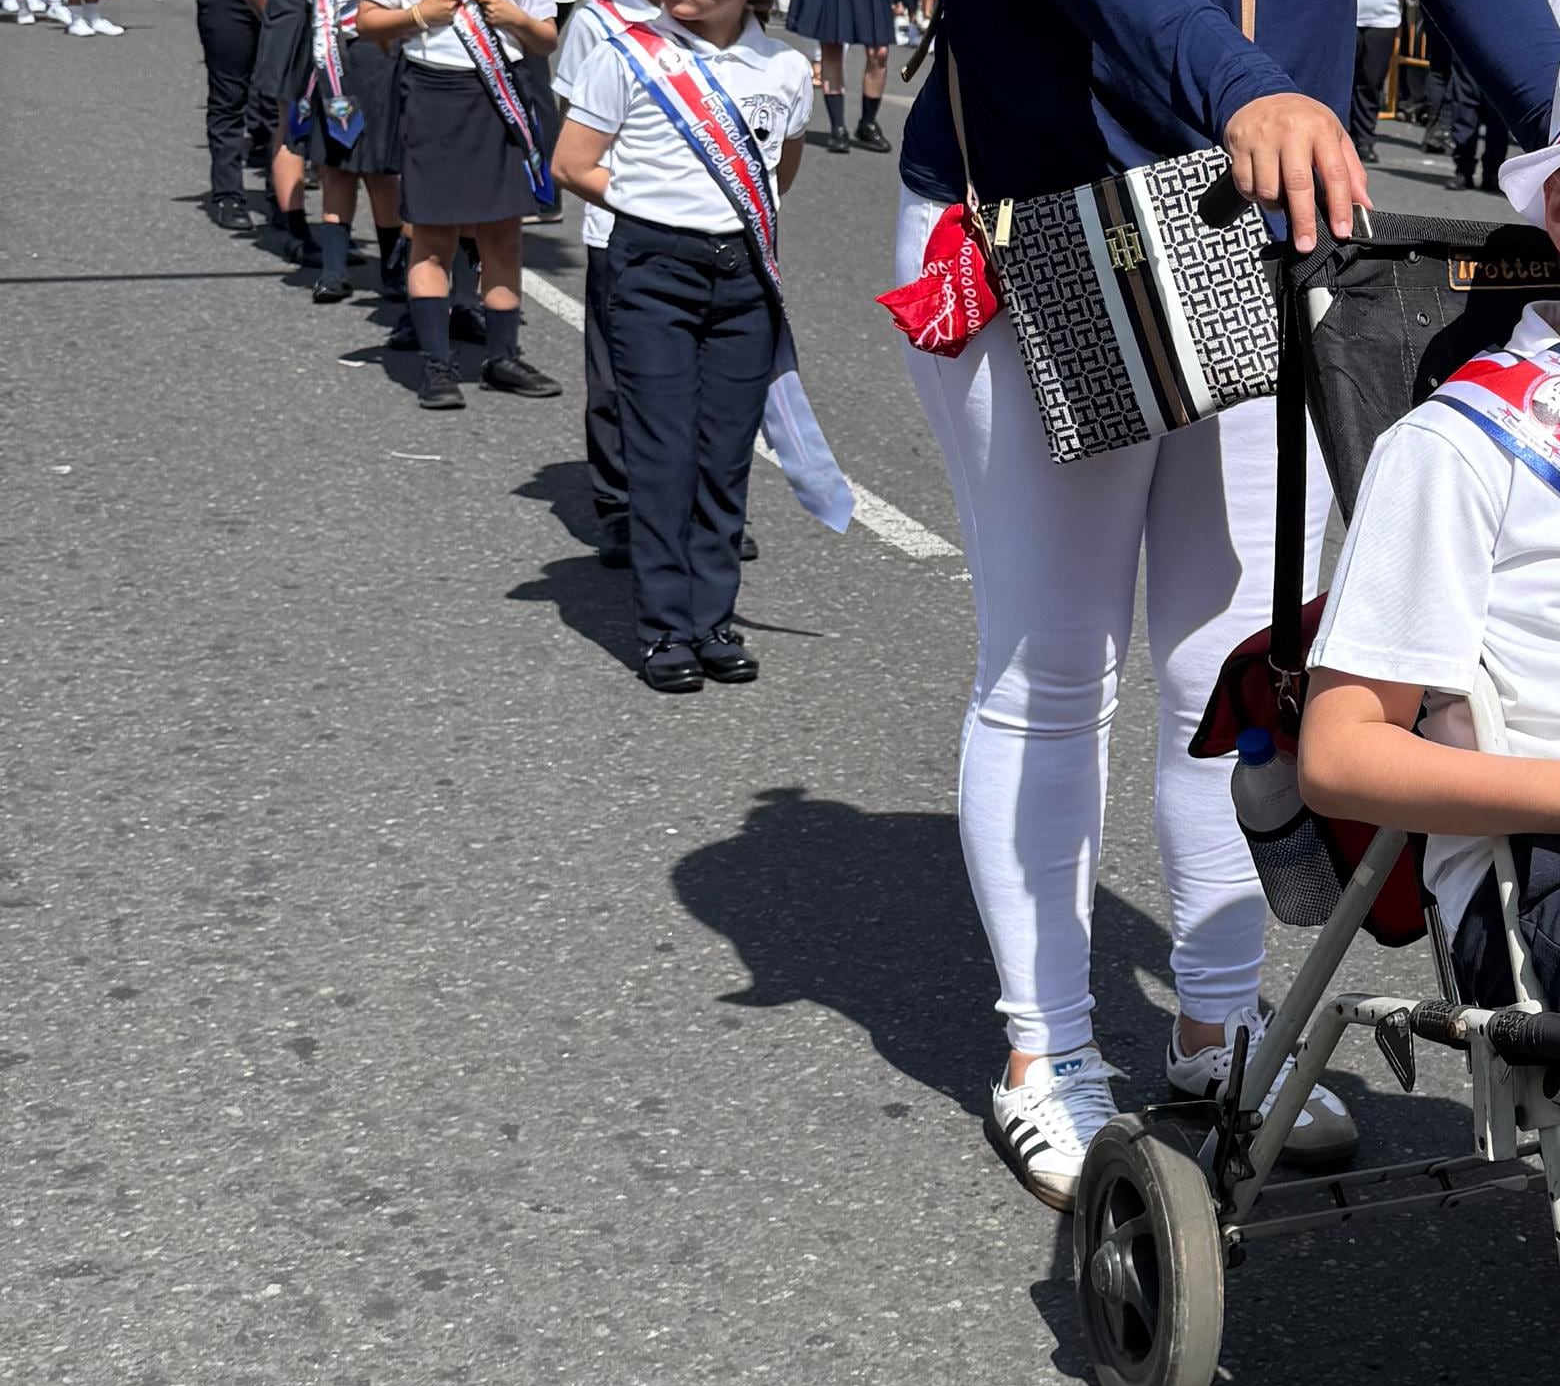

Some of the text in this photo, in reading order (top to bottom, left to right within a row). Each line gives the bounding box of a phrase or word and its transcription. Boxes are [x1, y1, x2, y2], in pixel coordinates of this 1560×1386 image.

[701, 90, 750, 161] Escuela
[690, 119, 750, 212] Excelencia
[1455, 253, 1556, 280] Trotter
